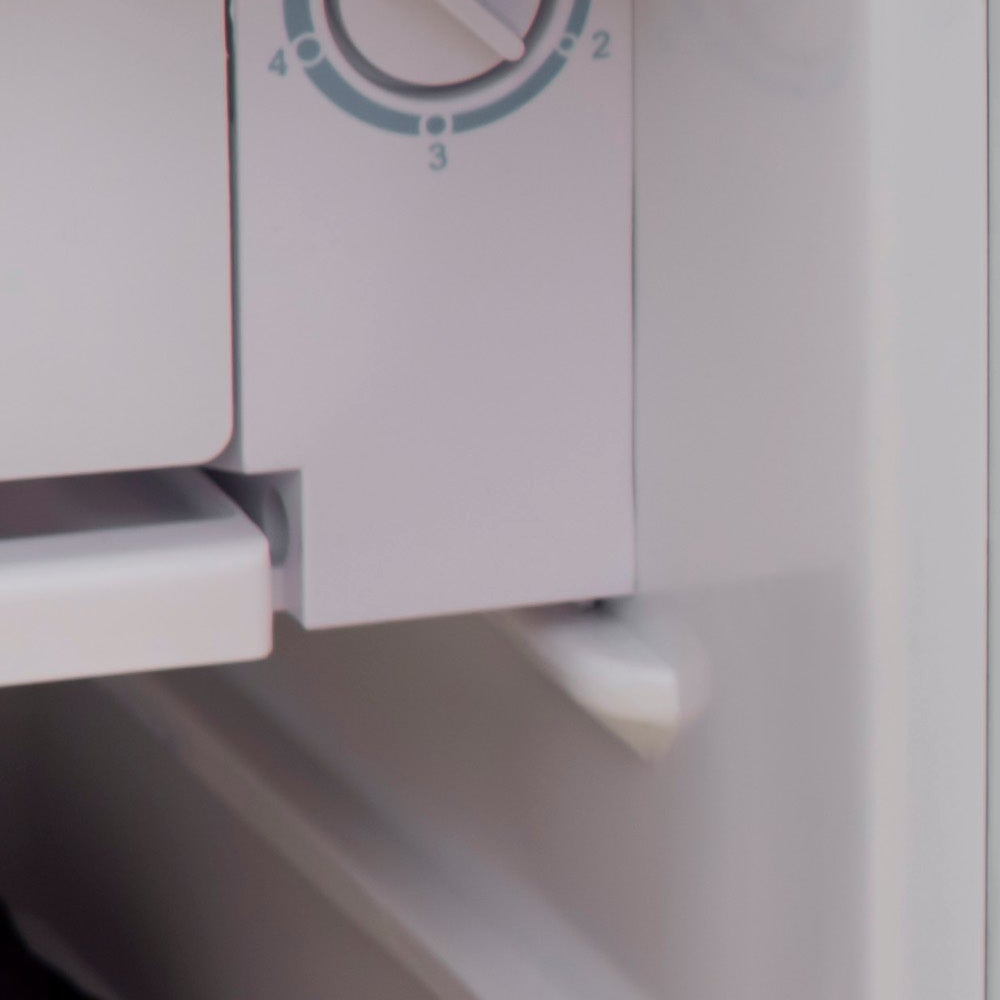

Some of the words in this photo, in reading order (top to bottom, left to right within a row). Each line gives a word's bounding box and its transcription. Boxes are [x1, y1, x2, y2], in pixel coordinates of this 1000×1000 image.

[592, 30, 611, 60] 2
[268, 48, 288, 76] 4
[428, 142, 448, 171] 3
